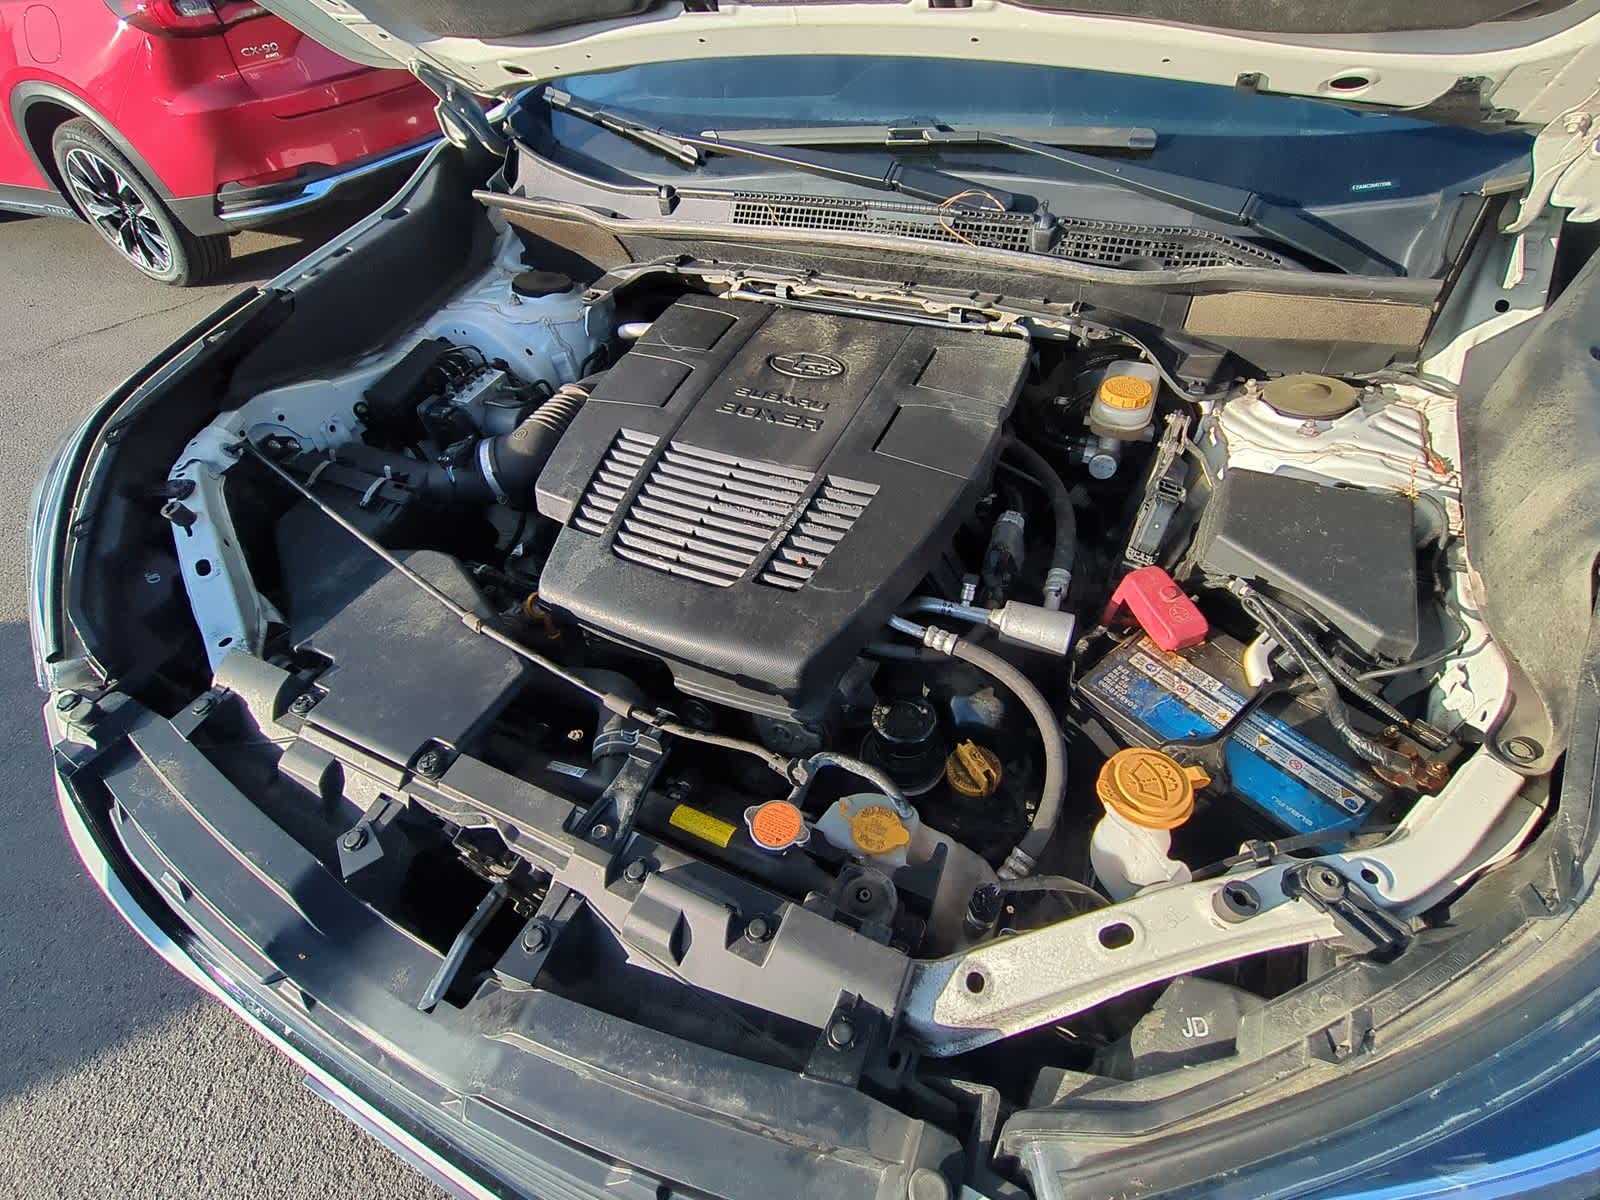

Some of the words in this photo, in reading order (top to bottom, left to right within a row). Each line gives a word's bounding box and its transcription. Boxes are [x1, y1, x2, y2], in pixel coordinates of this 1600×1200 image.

[240, 42, 279, 56] CX-90
[734, 386, 830, 413] SUBARU
[715, 402, 825, 432] BOXER
[1271, 795, 1314, 826] SUBARU
[1182, 1016, 1209, 1038] JD
